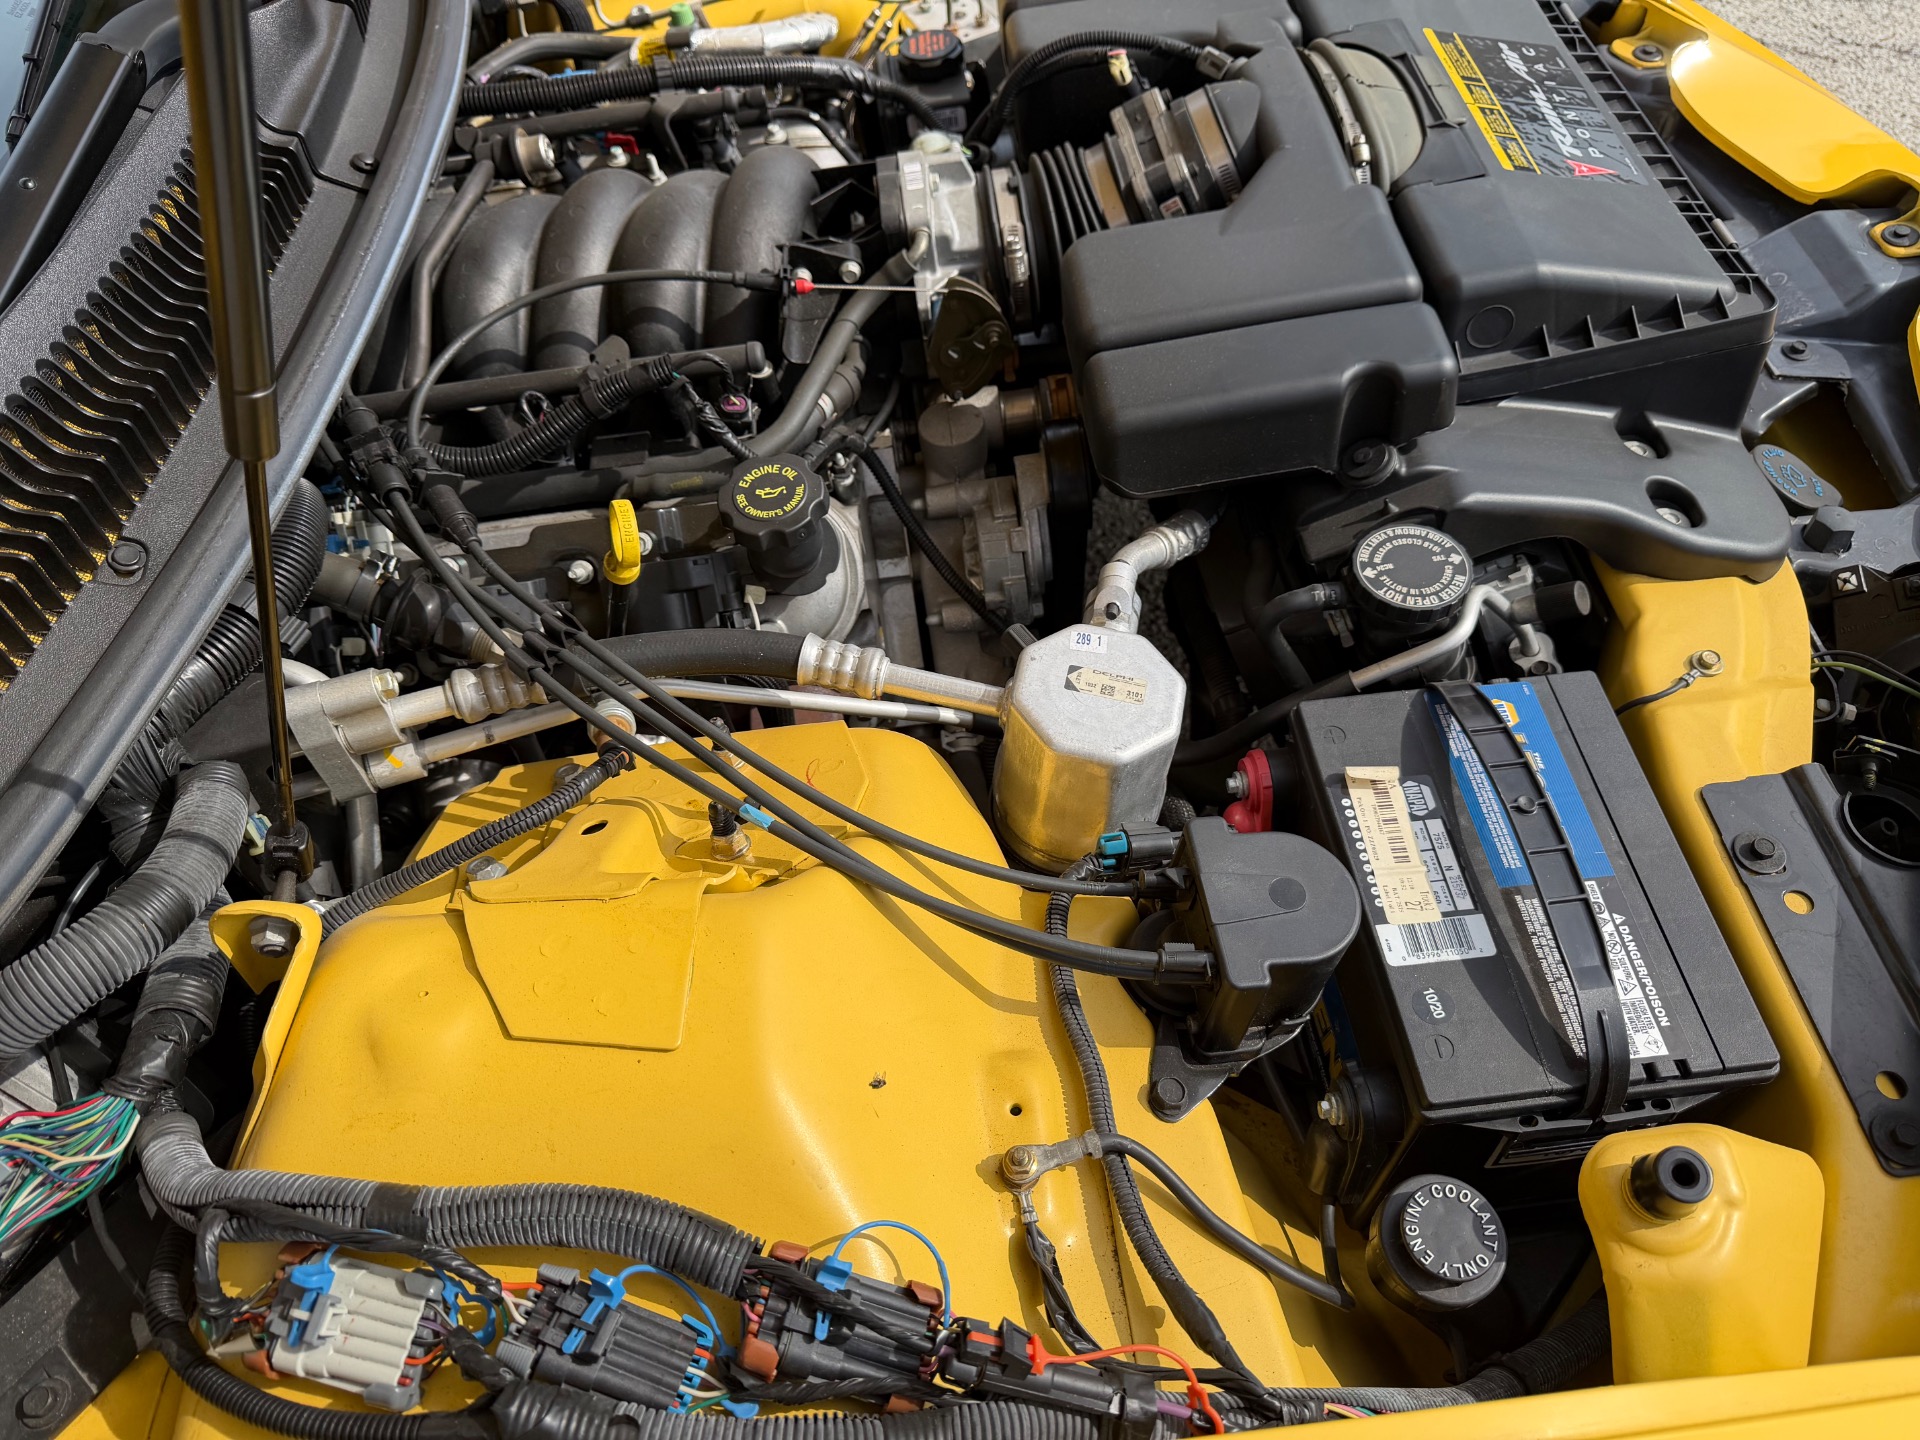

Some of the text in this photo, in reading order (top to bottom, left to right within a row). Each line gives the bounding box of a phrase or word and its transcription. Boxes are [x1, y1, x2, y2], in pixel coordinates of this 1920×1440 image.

[1523, 45, 1604, 158] PONTIAC
[739, 464, 798, 489] ENGINE OIL
[1762, 459, 1798, 496] WASHER
[736, 483, 805, 518] SEE OWNER'S MANUAL
[1368, 532, 1387, 548] VENT
[1392, 538, 1423, 547] CLOSED
[1394, 528, 1427, 537] ARROW
[1427, 532, 1452, 548] ALIGN
[1359, 543, 1371, 562] TUBE
[1372, 542, 1392, 563] SYSTEM
[1379, 575, 1408, 593] BOTTLE
[1440, 565, 1454, 586] CHECK
[1377, 574, 1466, 606] NEVER OPEN HOT
[1420, 582, 1442, 594] LEVEL
[1076, 632, 1102, 647] 289 1
[1092, 669, 1134, 682] DELPHI
[1533, 754, 1545, 769] THE
[1404, 789, 1427, 809] NAPA
[1432, 834, 1445, 849] 7575
[1405, 901, 1424, 912] 27
[1420, 892, 1433, 906] Truck
[1444, 947, 1471, 958] 11050
[1542, 926, 1552, 937] RISK
[1557, 964, 1574, 994] EXPLOSION
[1515, 896, 1530, 920] INVERTED
[1530, 935, 1544, 957] FOLLOW
[1539, 960, 1553, 981] PROPER
[1548, 983, 1565, 1011] CHARGING
[1561, 1014, 1584, 1057] INSTRUCTIONS.
[1524, 900, 1544, 935] DISASSEMBLE
[1556, 981, 1566, 992] NOT
[1561, 995, 1583, 1037] RECOMMENDED
[1617, 958, 1634, 980] SULFURIC
[1618, 926, 1670, 1025] DANGER/POISON
[1422, 987, 1446, 1017] 10/20
[1621, 1003, 1641, 1034] WITH WATER.
[1629, 1001, 1649, 1034] IMMEDIATELY
[1636, 1000, 1655, 1029] FLUSH EYES
[1405, 1191, 1435, 1265] ENGINE
[1431, 1184, 1498, 1251] COOLANT
[1439, 1253, 1490, 1278] ONLY
